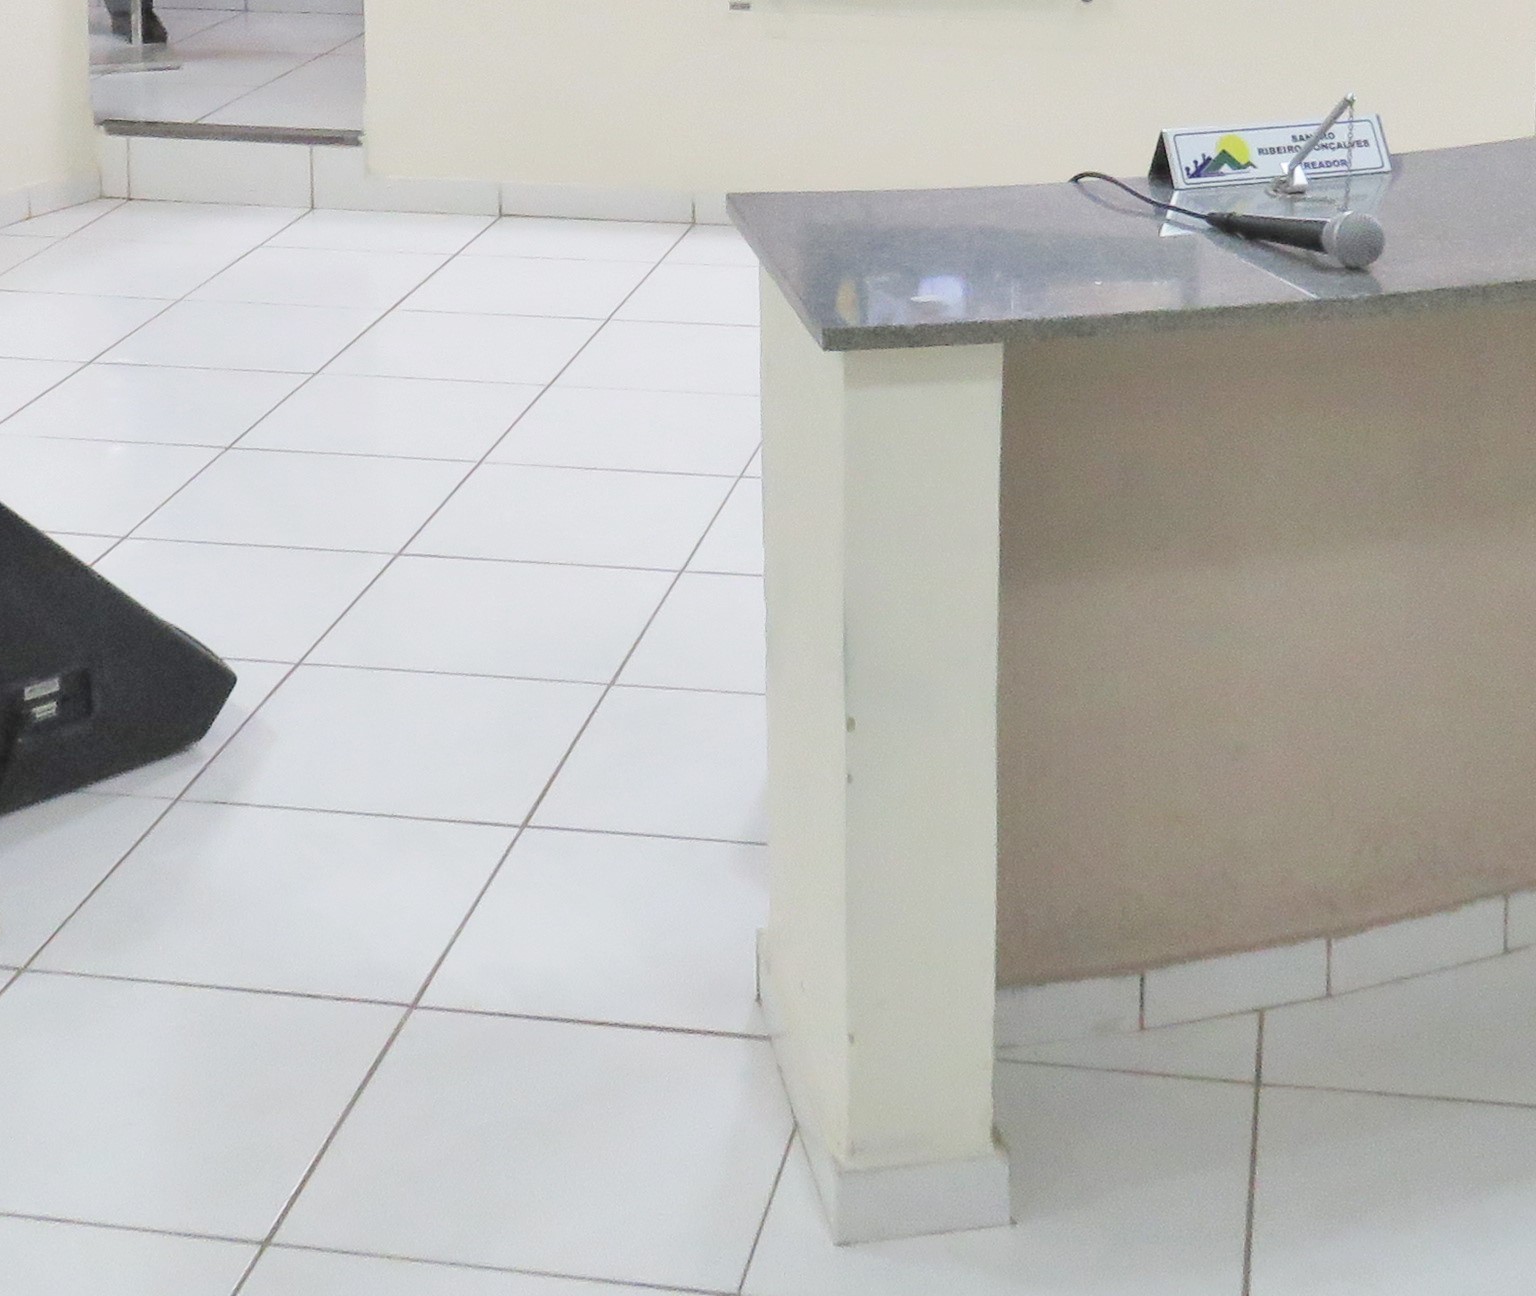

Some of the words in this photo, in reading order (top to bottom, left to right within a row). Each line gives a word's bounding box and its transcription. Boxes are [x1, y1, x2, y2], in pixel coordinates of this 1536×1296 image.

[1257, 144, 1302, 156] RIBEIRO
[1311, 139, 1370, 153] ONÇALVES
[1300, 158, 1349, 170] READOR
